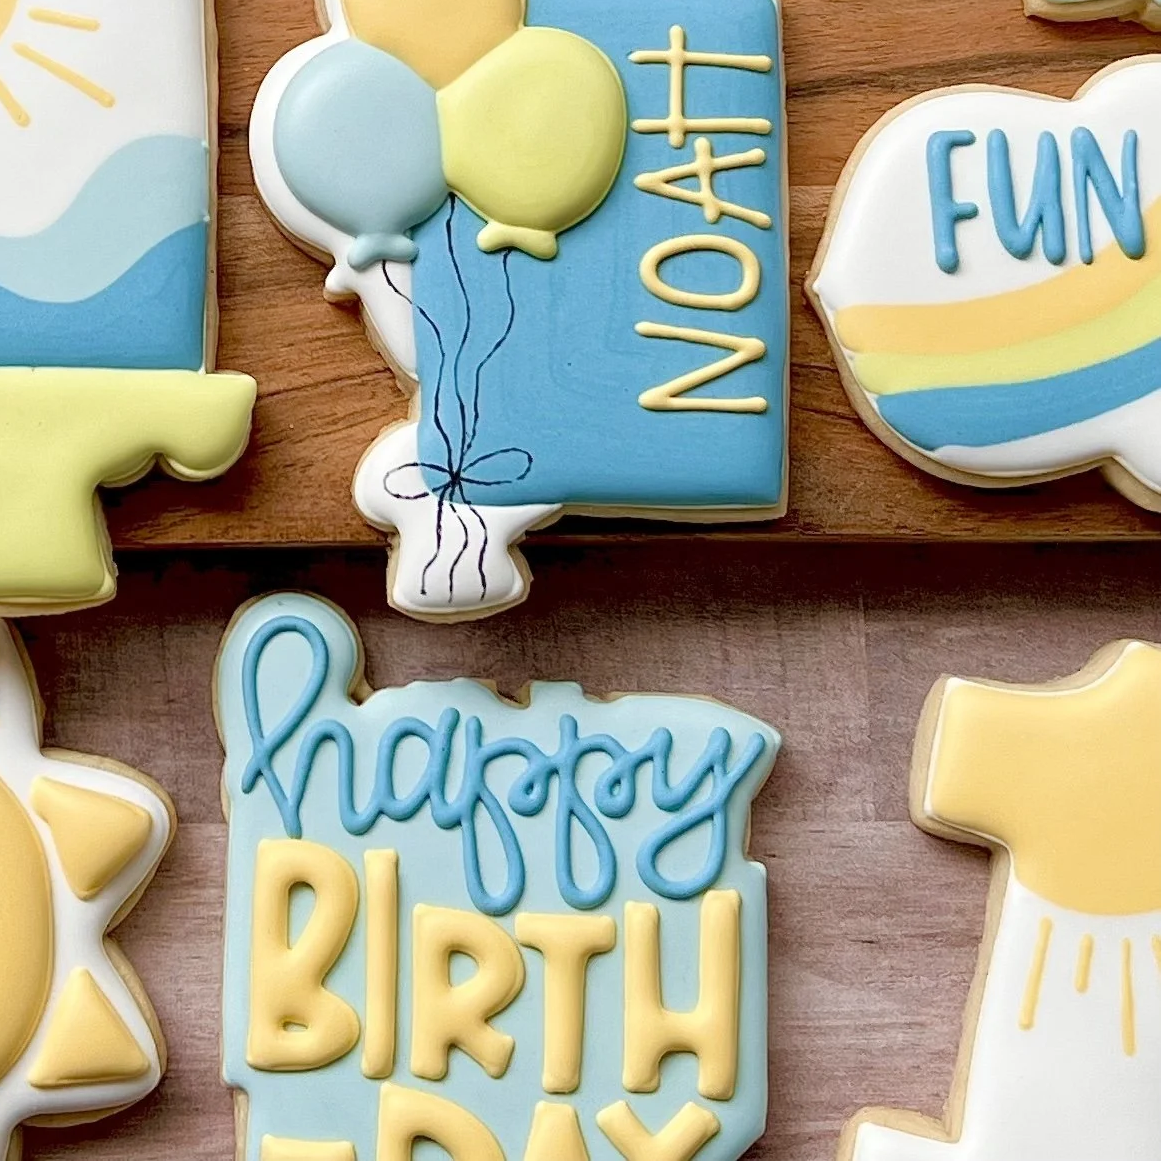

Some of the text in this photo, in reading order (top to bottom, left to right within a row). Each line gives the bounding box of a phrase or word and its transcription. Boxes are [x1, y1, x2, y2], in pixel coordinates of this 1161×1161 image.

[627, 24, 773, 414] NOAH
[926, 126, 1146, 274] FUN
[241, 615, 766, 916] happy
[246, 838, 742, 1100] BIRTH
